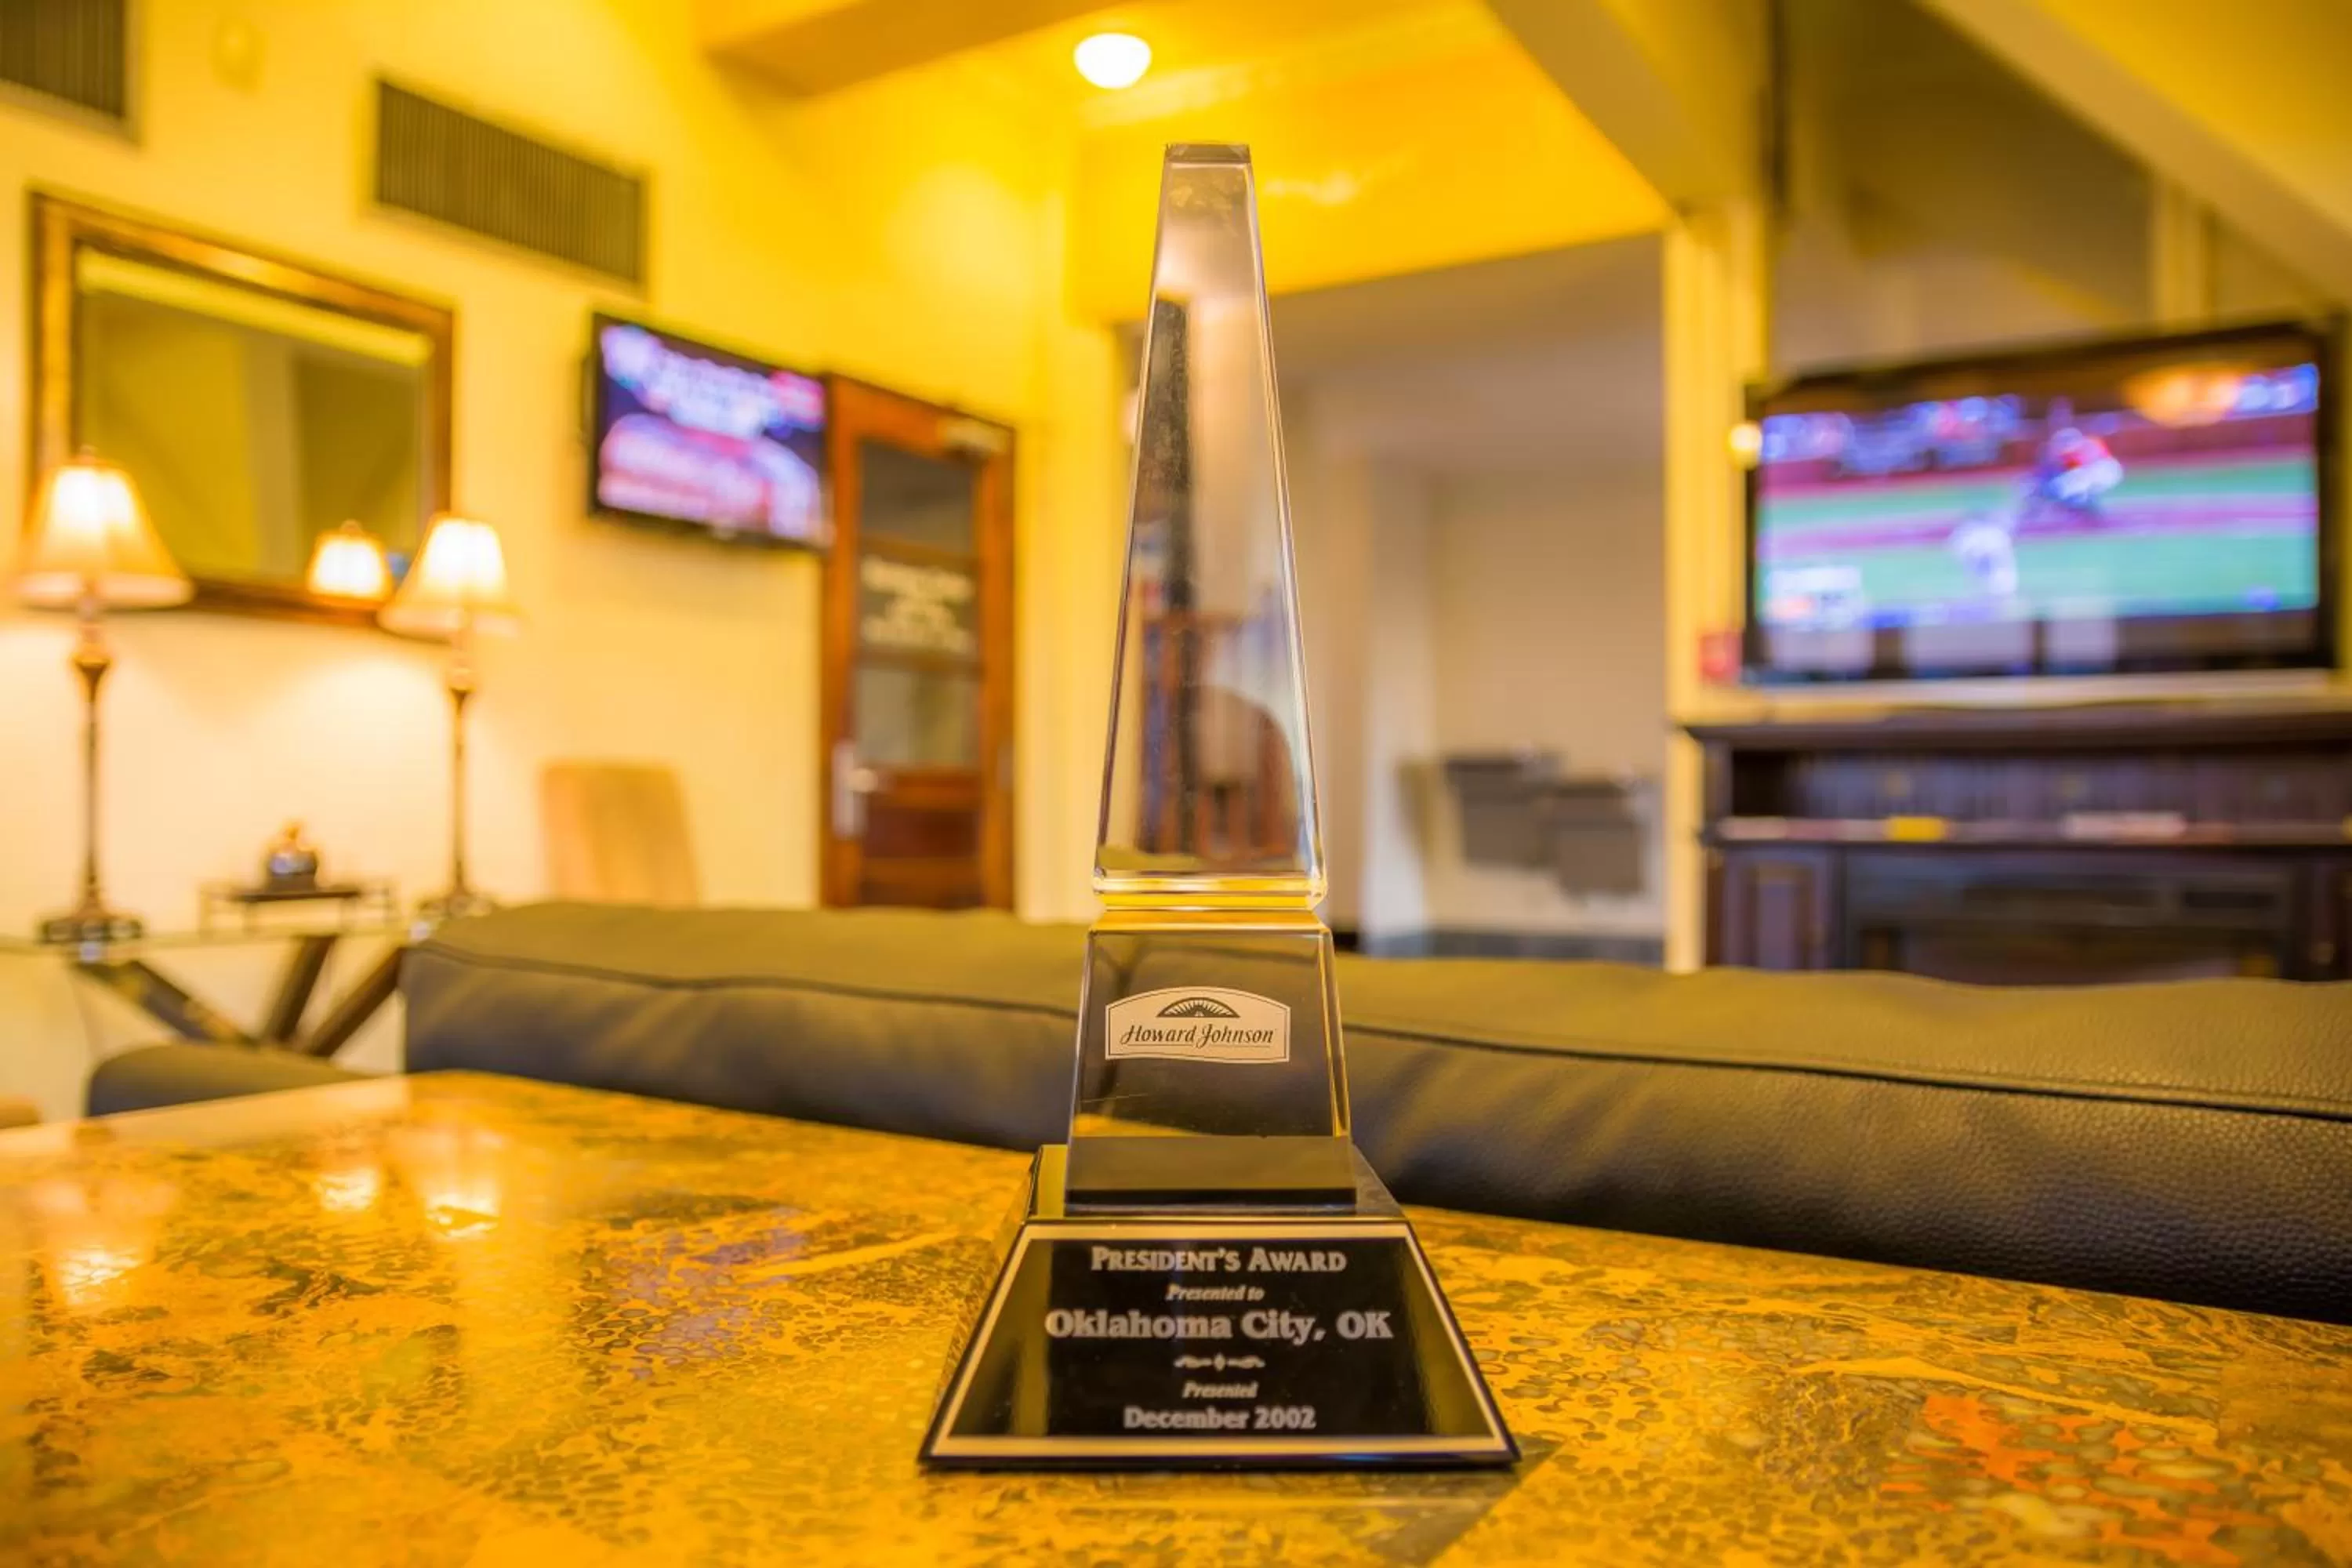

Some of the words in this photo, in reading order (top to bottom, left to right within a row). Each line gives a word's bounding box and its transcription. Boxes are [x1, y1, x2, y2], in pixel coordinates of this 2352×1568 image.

[1120, 1024, 1197, 1044] Howard
[1196, 1023, 1275, 1048] Johnson
[1091, 1246, 1241, 1272] PRESIDENT'S
[1248, 1247, 1348, 1272] AWARD
[1165, 1283, 1246, 1301] Presented
[1247, 1286, 1265, 1301] to
[1044, 1308, 1232, 1338] Oklahoma
[1240, 1309, 1327, 1345] City,
[1336, 1311, 1394, 1339] OK
[1182, 1381, 1258, 1399] Presented
[1123, 1405, 1250, 1429] December
[1254, 1406, 1316, 1429] 2002
